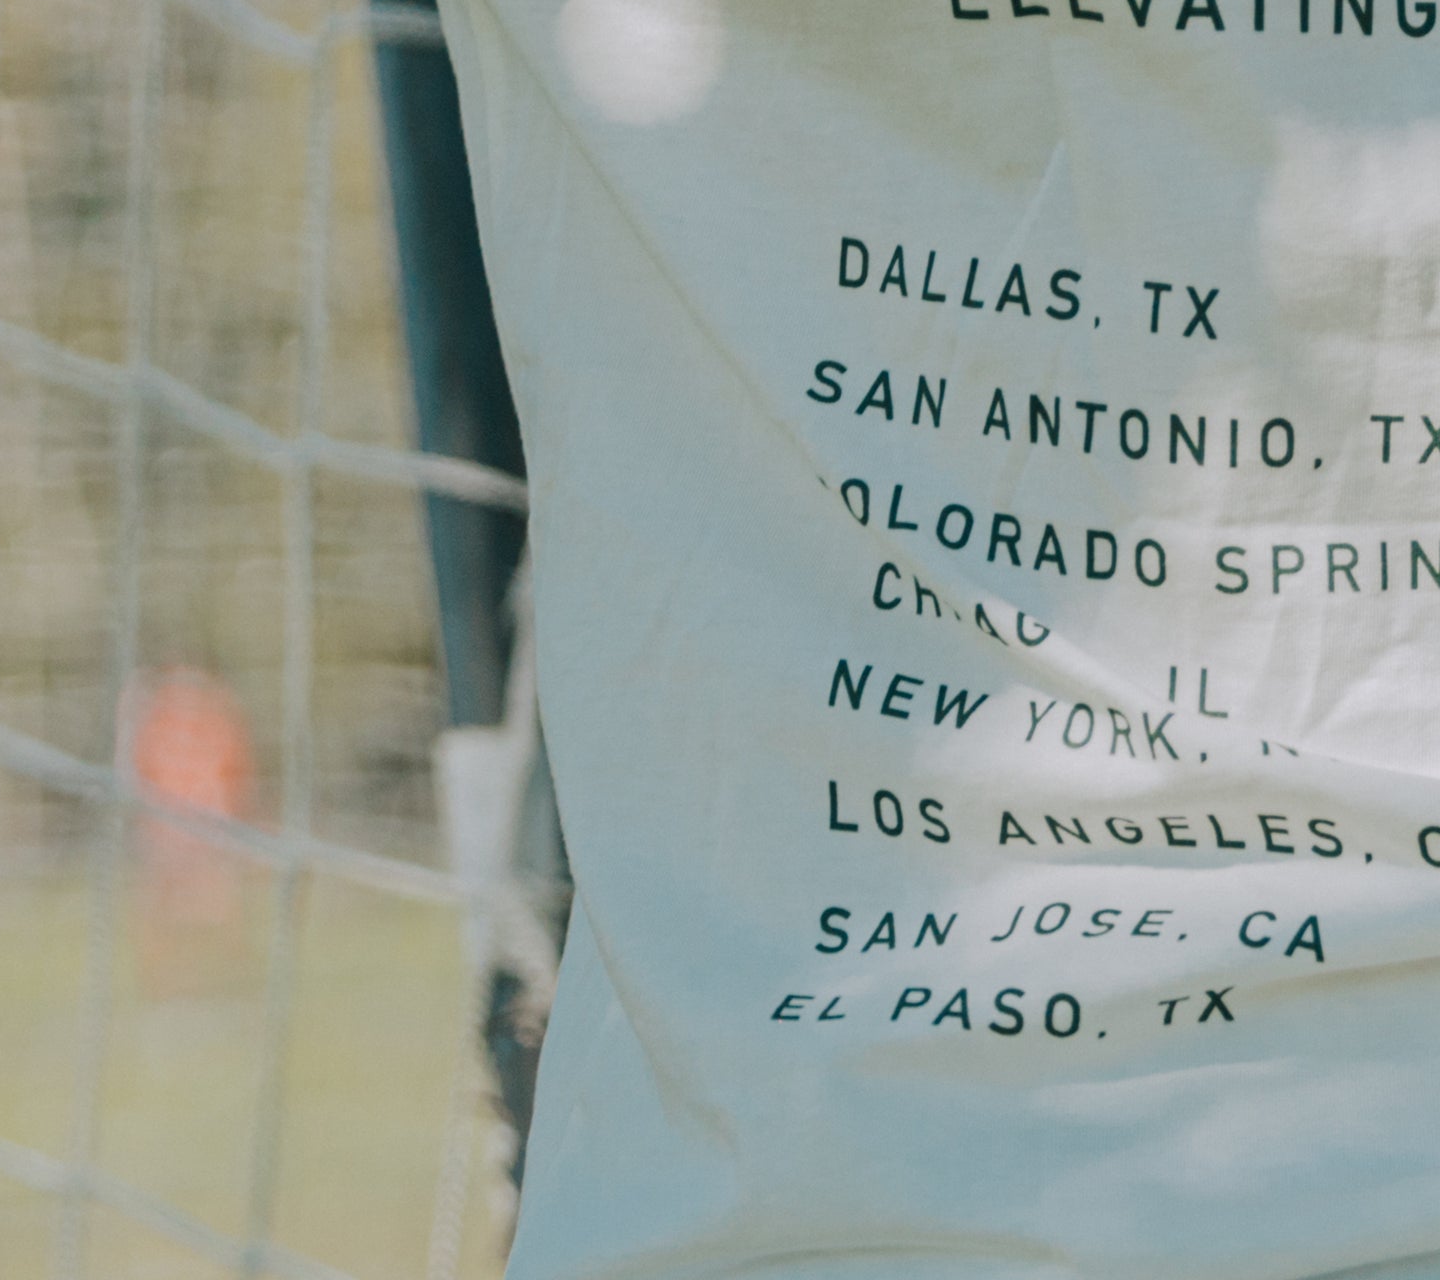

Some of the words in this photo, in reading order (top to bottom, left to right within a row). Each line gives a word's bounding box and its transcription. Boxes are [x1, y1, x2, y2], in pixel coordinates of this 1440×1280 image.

[837, 234, 1102, 330] DALLAS,
[1141, 279, 1221, 342] TX
[804, 357, 949, 430] SAN
[981, 386, 1325, 472] ANTONIO,
[816, 473, 1167, 587] OLORADO
[826, 657, 991, 731] NEW
[1025, 700, 1208, 763] YORK,
[827, 778, 952, 846] LOS
[997, 809, 1375, 866] ANGELES,
[813, 904, 959, 956] SAN
[1237, 909, 1326, 965] CA
[769, 992, 847, 1023] EL
[1156, 985, 1236, 1028] TX
